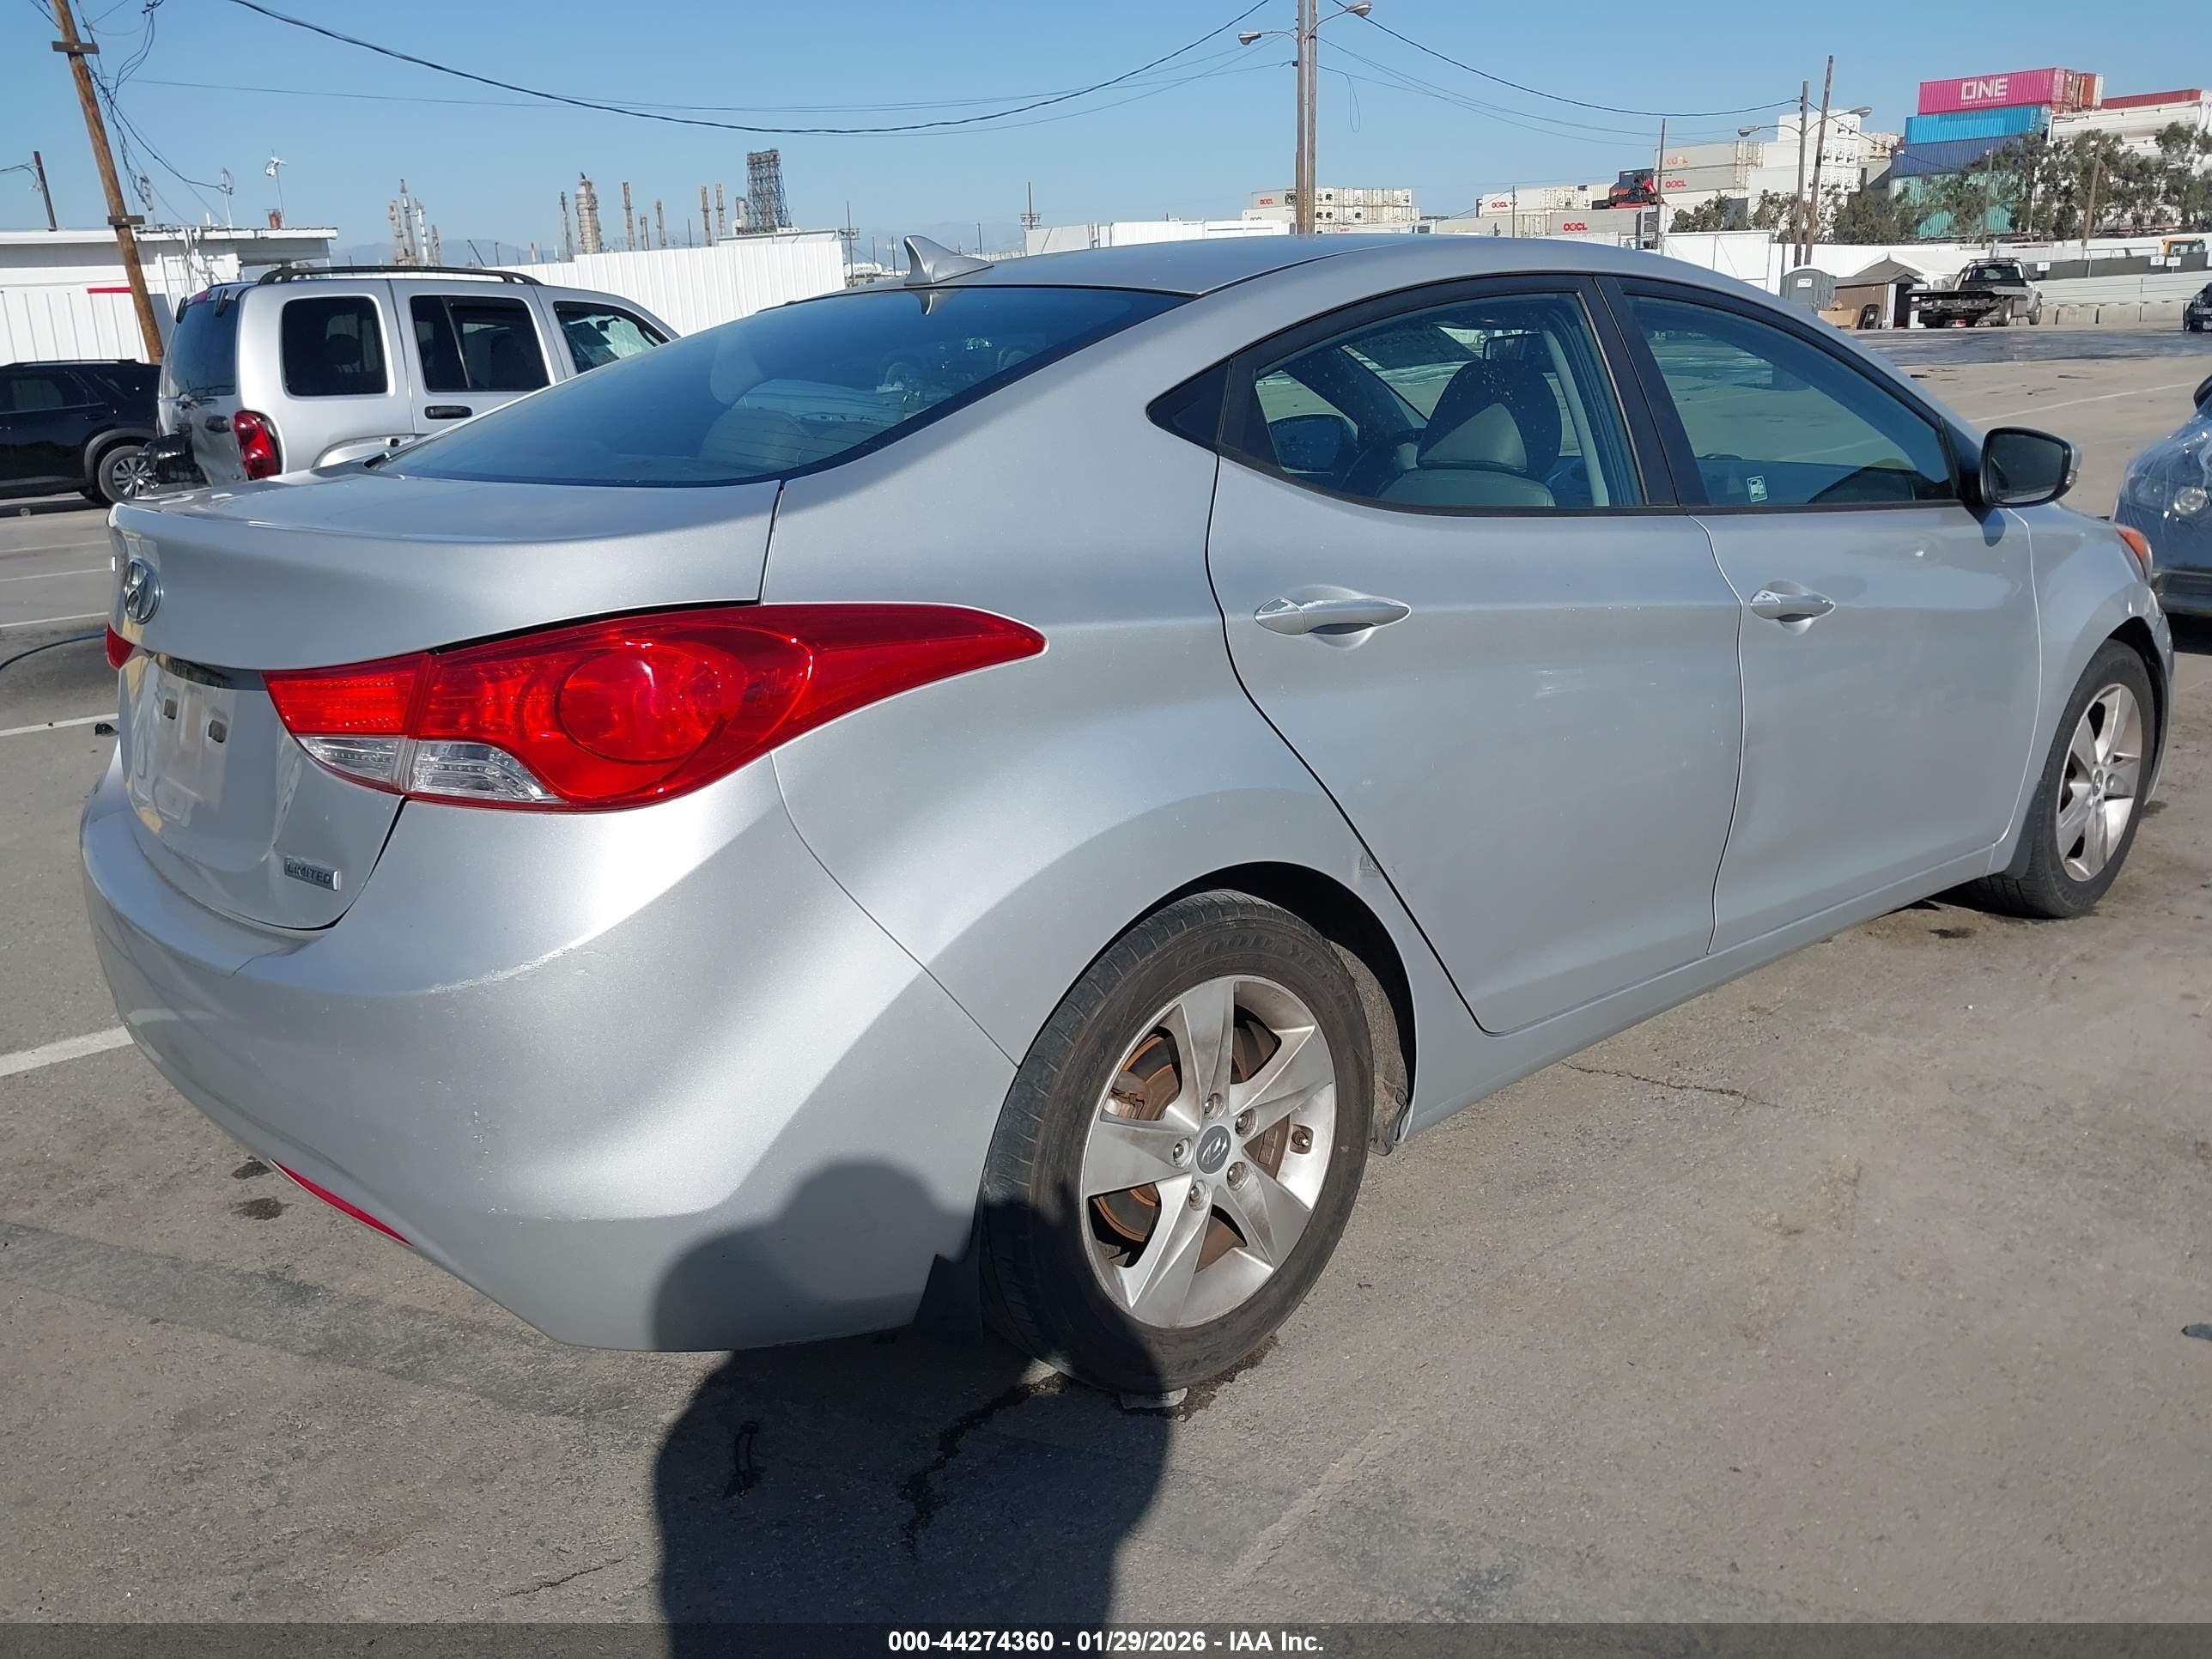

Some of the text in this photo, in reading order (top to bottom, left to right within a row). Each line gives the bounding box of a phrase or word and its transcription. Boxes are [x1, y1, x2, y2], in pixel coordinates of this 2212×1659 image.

[1961, 77, 2008, 100] ONE
[1665, 179, 1687, 188] OOCL
[1563, 222, 1588, 231] OOCL
[287, 862, 331, 884] LIMITED
